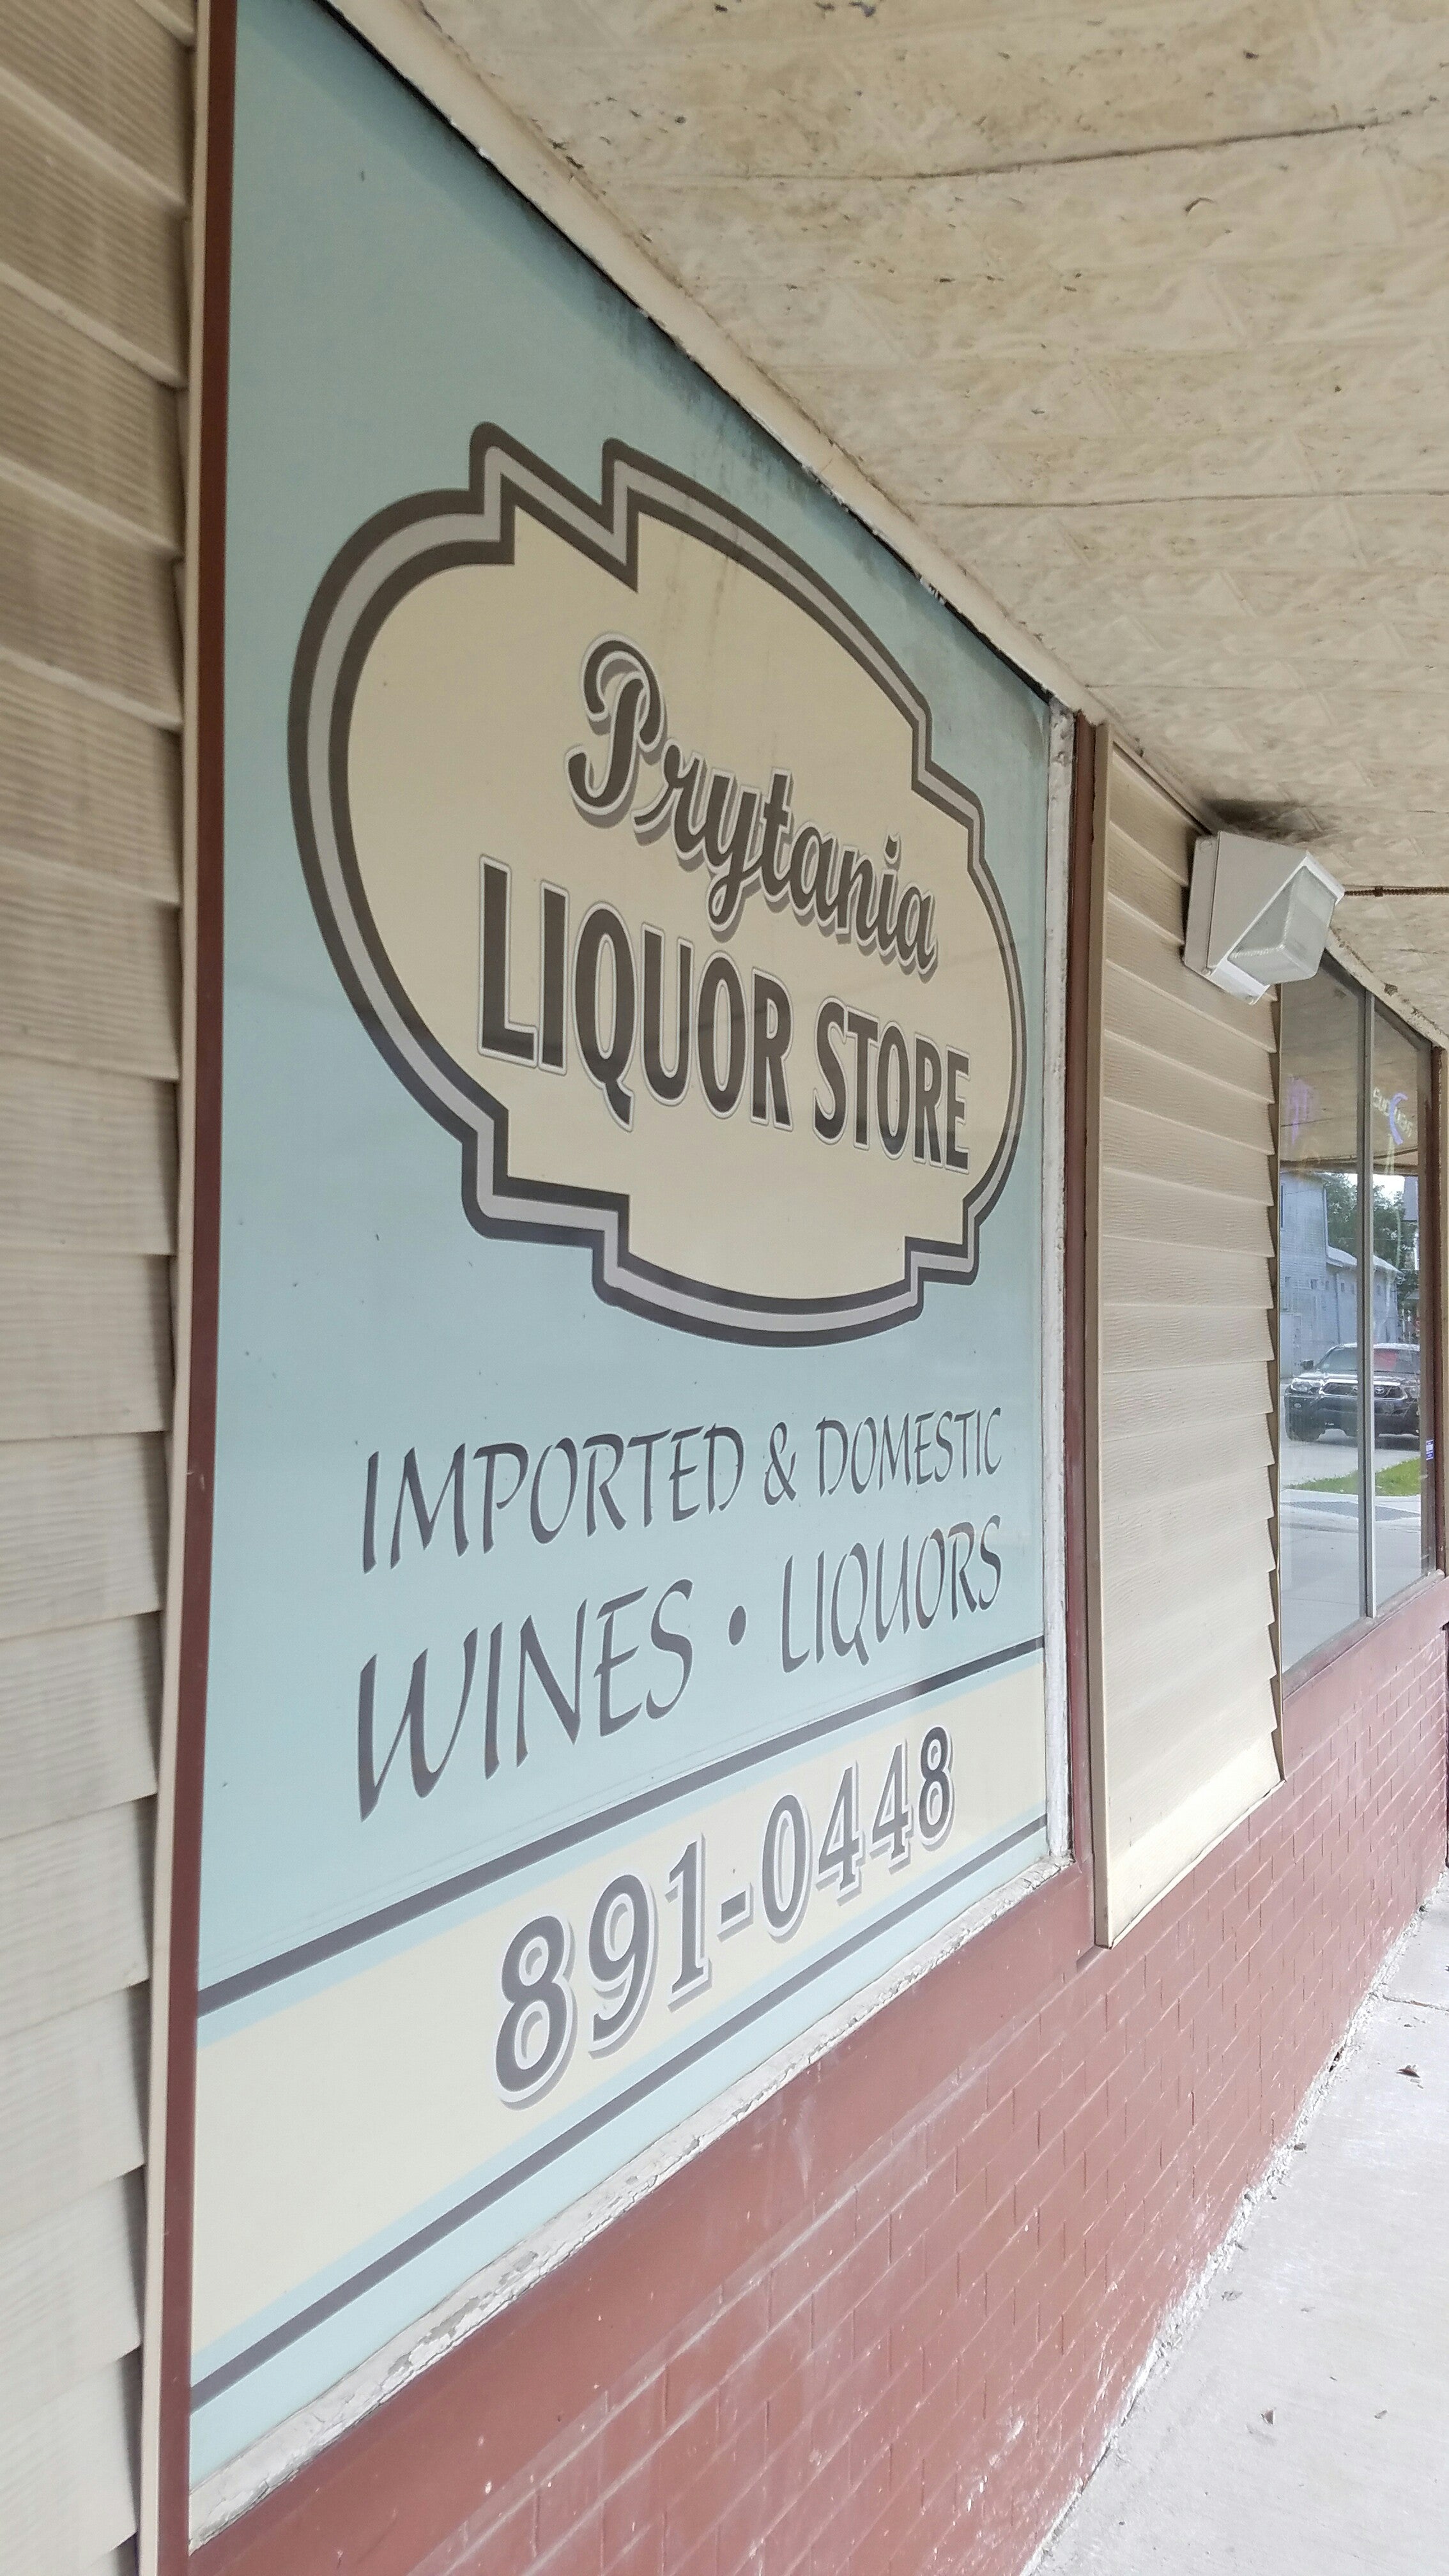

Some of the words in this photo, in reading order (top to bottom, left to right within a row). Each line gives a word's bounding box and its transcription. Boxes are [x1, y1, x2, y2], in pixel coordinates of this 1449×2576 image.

[565, 631, 938, 980] Prytania
[479, 855, 793, 1131] LIQUOR
[813, 996, 970, 1174] STORE
[362, 1423, 744, 1574] IMPORTED
[764, 1422, 797, 1505] &
[815, 1407, 1002, 1497] DOMESTIC
[358, 1579, 694, 1821] WINES
[781, 1514, 1002, 1673] LIQUORS
[495, 1725, 954, 2110] 891-0448
